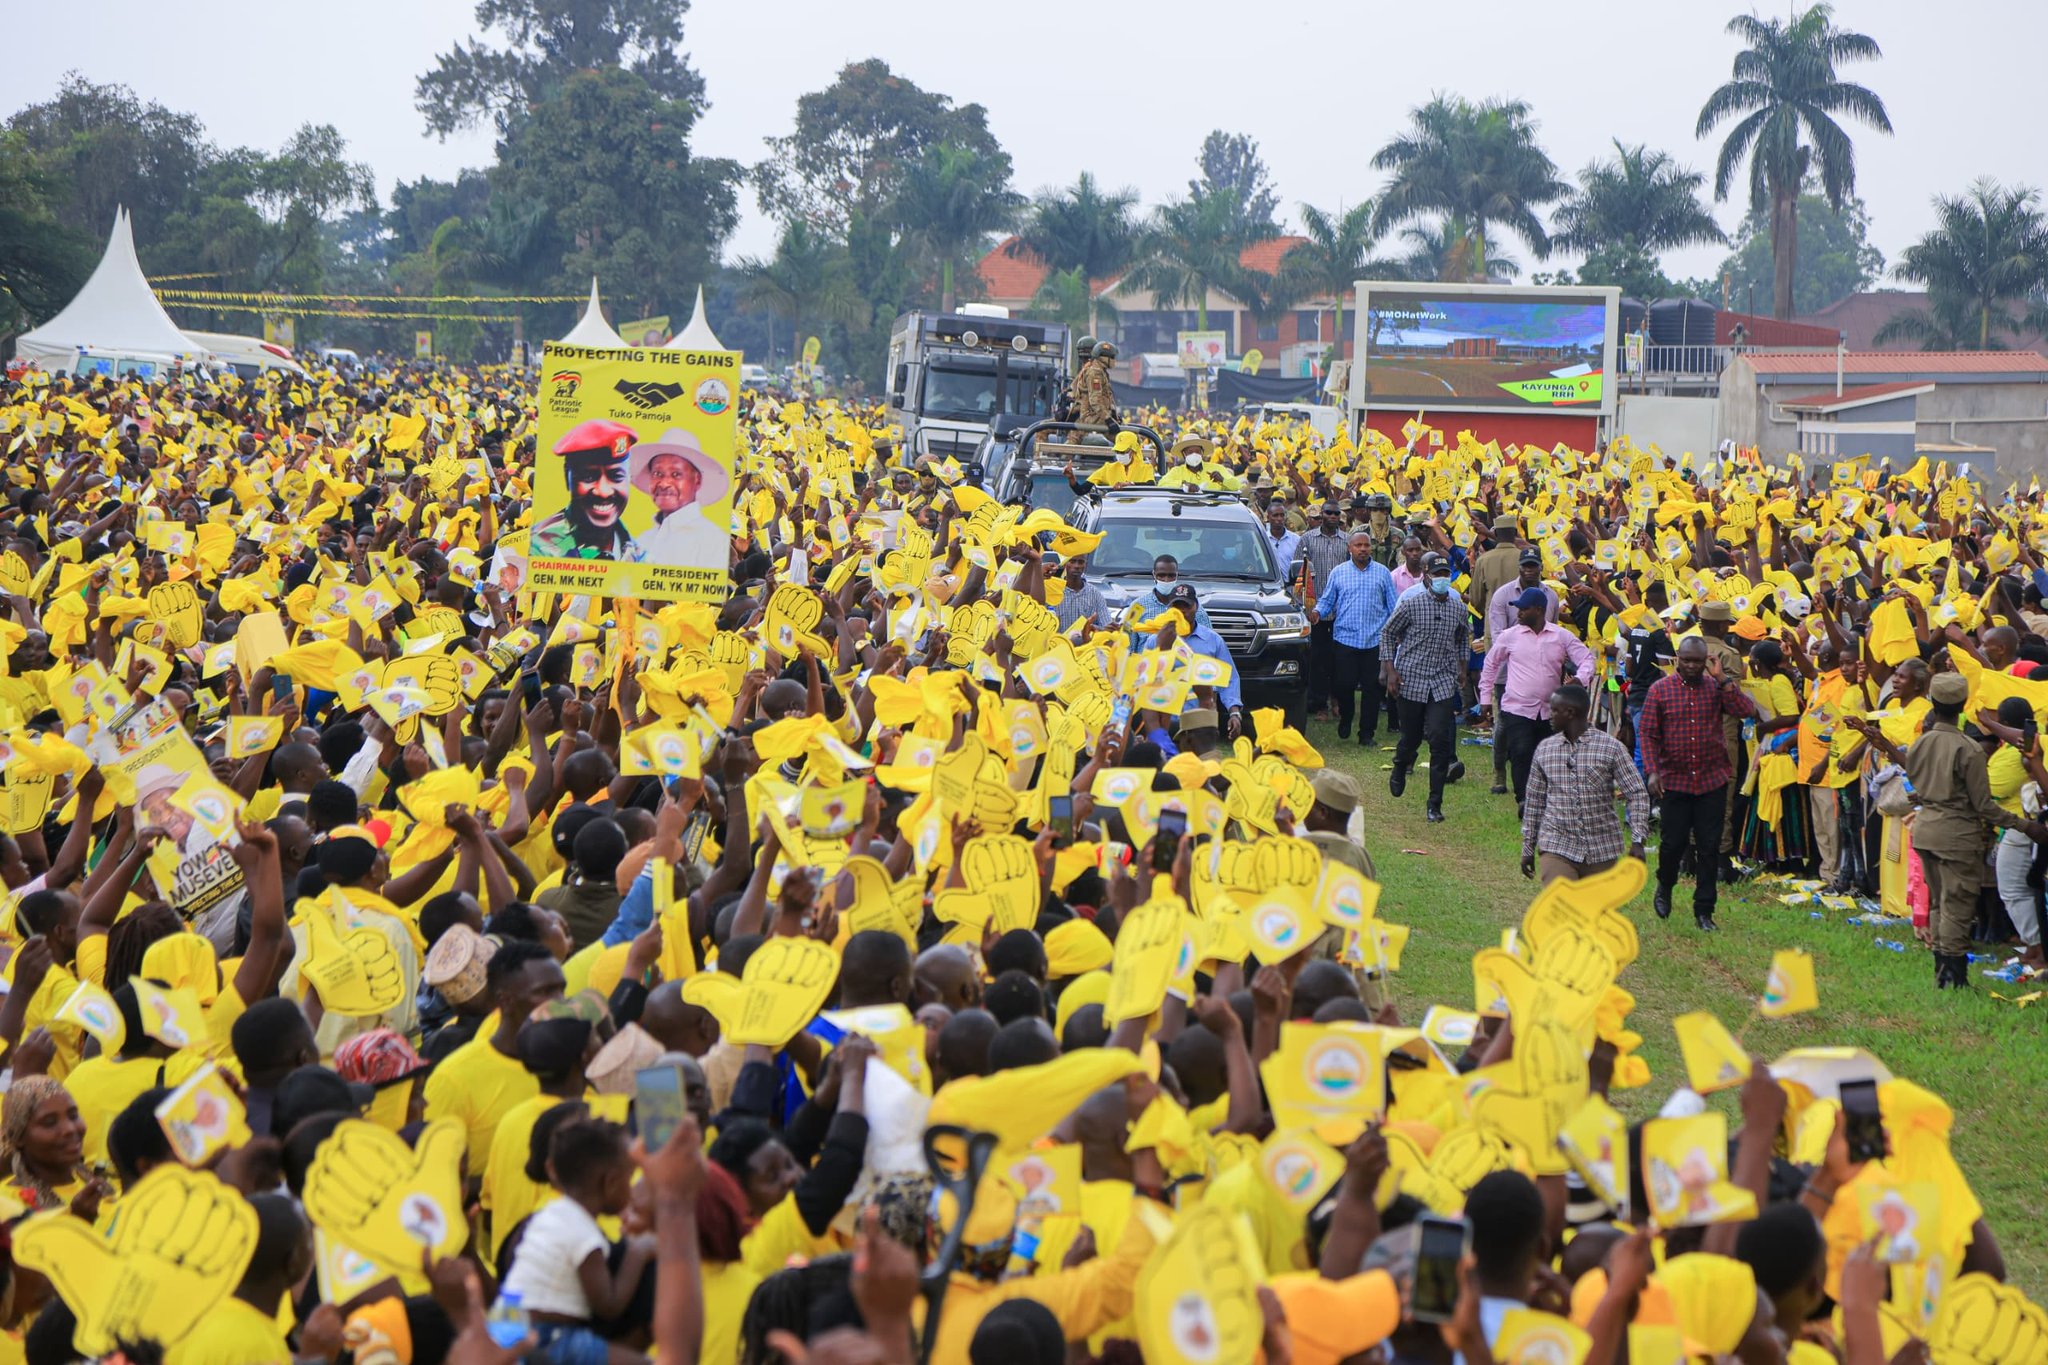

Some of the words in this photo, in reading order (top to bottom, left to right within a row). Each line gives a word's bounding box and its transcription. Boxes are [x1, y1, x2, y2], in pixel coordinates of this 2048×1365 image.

[1378, 310, 1447, 320] #MOHatWork
[543, 345, 644, 362] PROTECTING
[650, 352, 681, 365] THE
[685, 354, 734, 368] GAINS
[1521, 383, 1575, 392] KAYUNGA
[549, 398, 583, 407] Patriotic
[551, 405, 580, 414] League
[609, 410, 633, 419] Tuko
[634, 411, 672, 422] Pamoja
[531, 561, 586, 573] CHAIRMAN
[588, 564, 608, 574] PLU
[533, 574, 557, 586] GEN.
[559, 575, 575, 587] MK
[577, 576, 604, 588] NEXT
[652, 568, 719, 581] PRESIDENT
[642, 579, 666, 592] GEN.
[669, 581, 683, 593] YK
[685, 581, 700, 594] M7
[702, 583, 726, 596] NOW
[169, 854, 235, 905] MUSEVE
